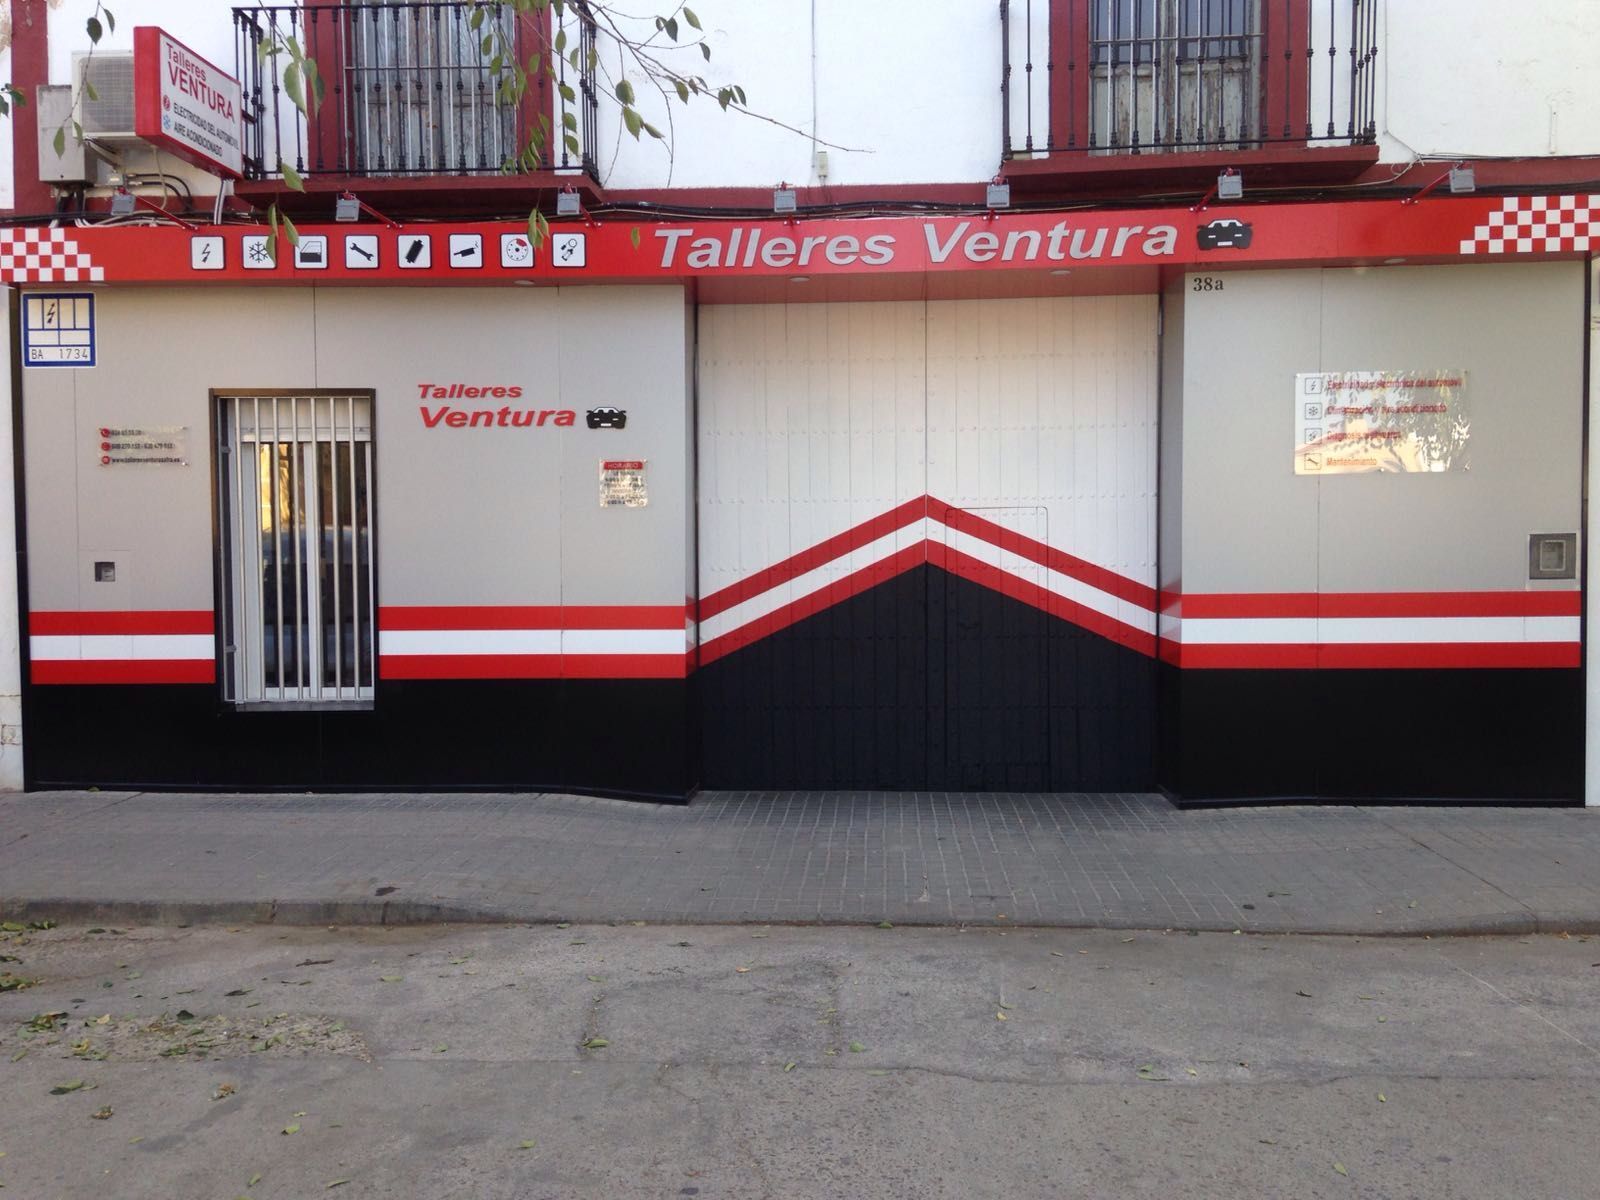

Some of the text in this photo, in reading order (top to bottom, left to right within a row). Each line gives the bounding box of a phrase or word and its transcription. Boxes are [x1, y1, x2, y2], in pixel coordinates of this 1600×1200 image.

[166, 42, 206, 81] Talleres
[168, 61, 235, 124] VENTURA
[174, 122, 186, 137] AIRE
[654, 220, 1179, 269] Talleres Ventura
[1193, 276, 1224, 291] 38a
[31, 348, 88, 360] BA 1734
[418, 383, 523, 399] Talleres
[419, 405, 577, 428] Ventura
